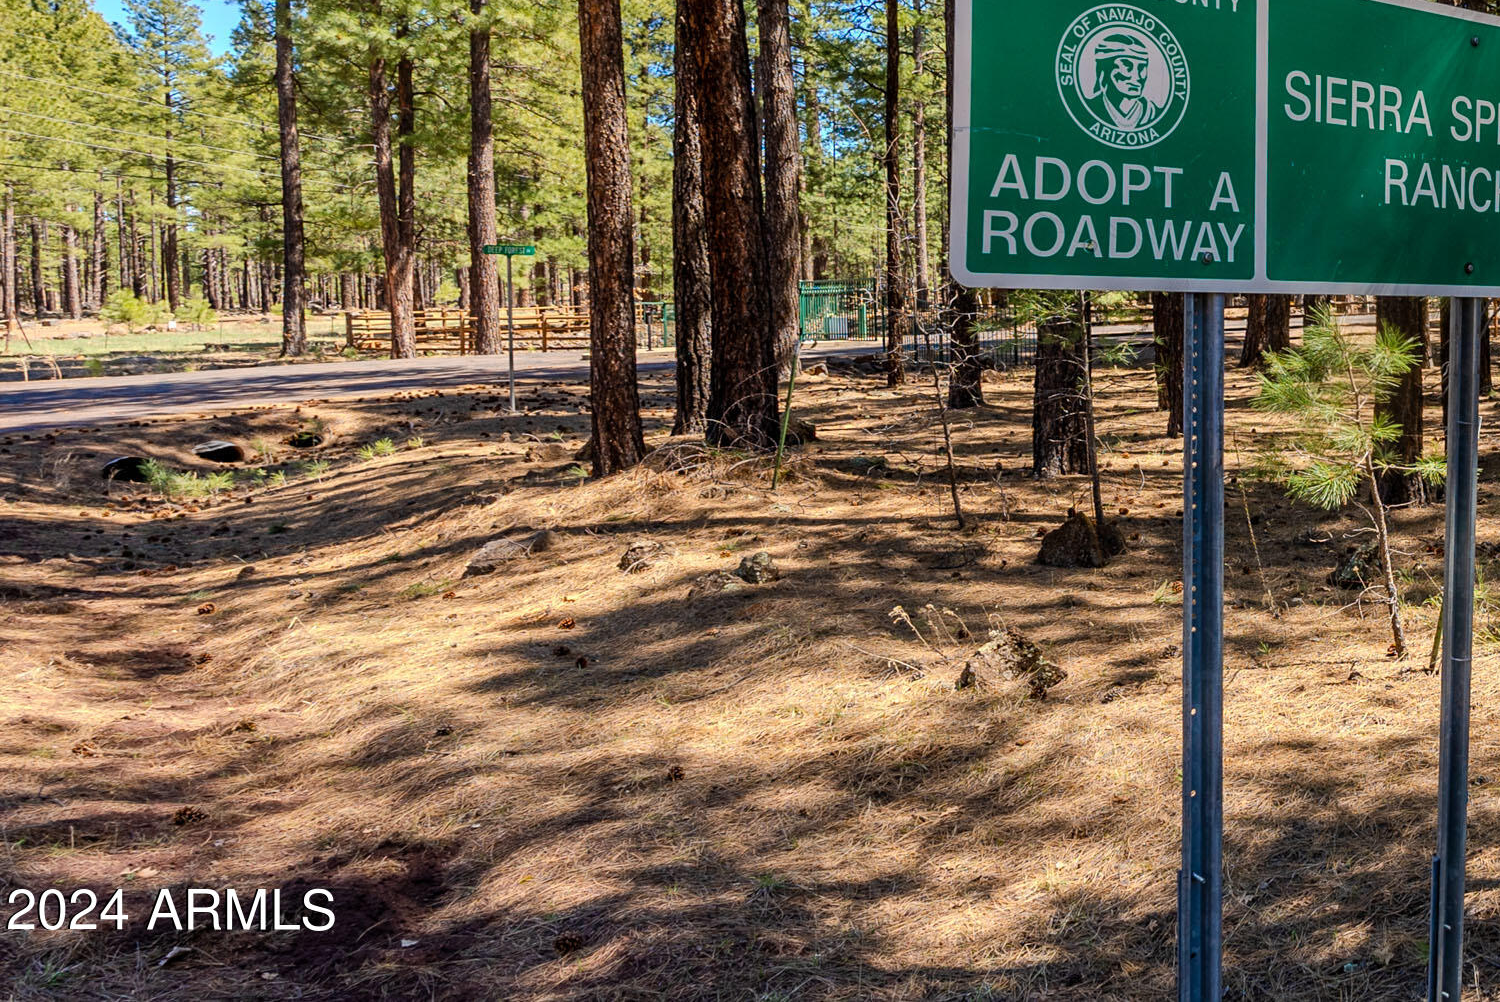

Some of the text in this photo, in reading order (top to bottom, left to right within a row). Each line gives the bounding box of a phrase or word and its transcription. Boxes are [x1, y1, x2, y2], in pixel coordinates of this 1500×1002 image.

[1060, 8, 1187, 100] SEAL OF NAVAJO COUNTY
[1284, 70, 1433, 137] SIERRA
[1090, 122, 1160, 145] ARIZONA
[990, 154, 1240, 212] ADOPT A
[981, 209, 1246, 263] ROADWAY
